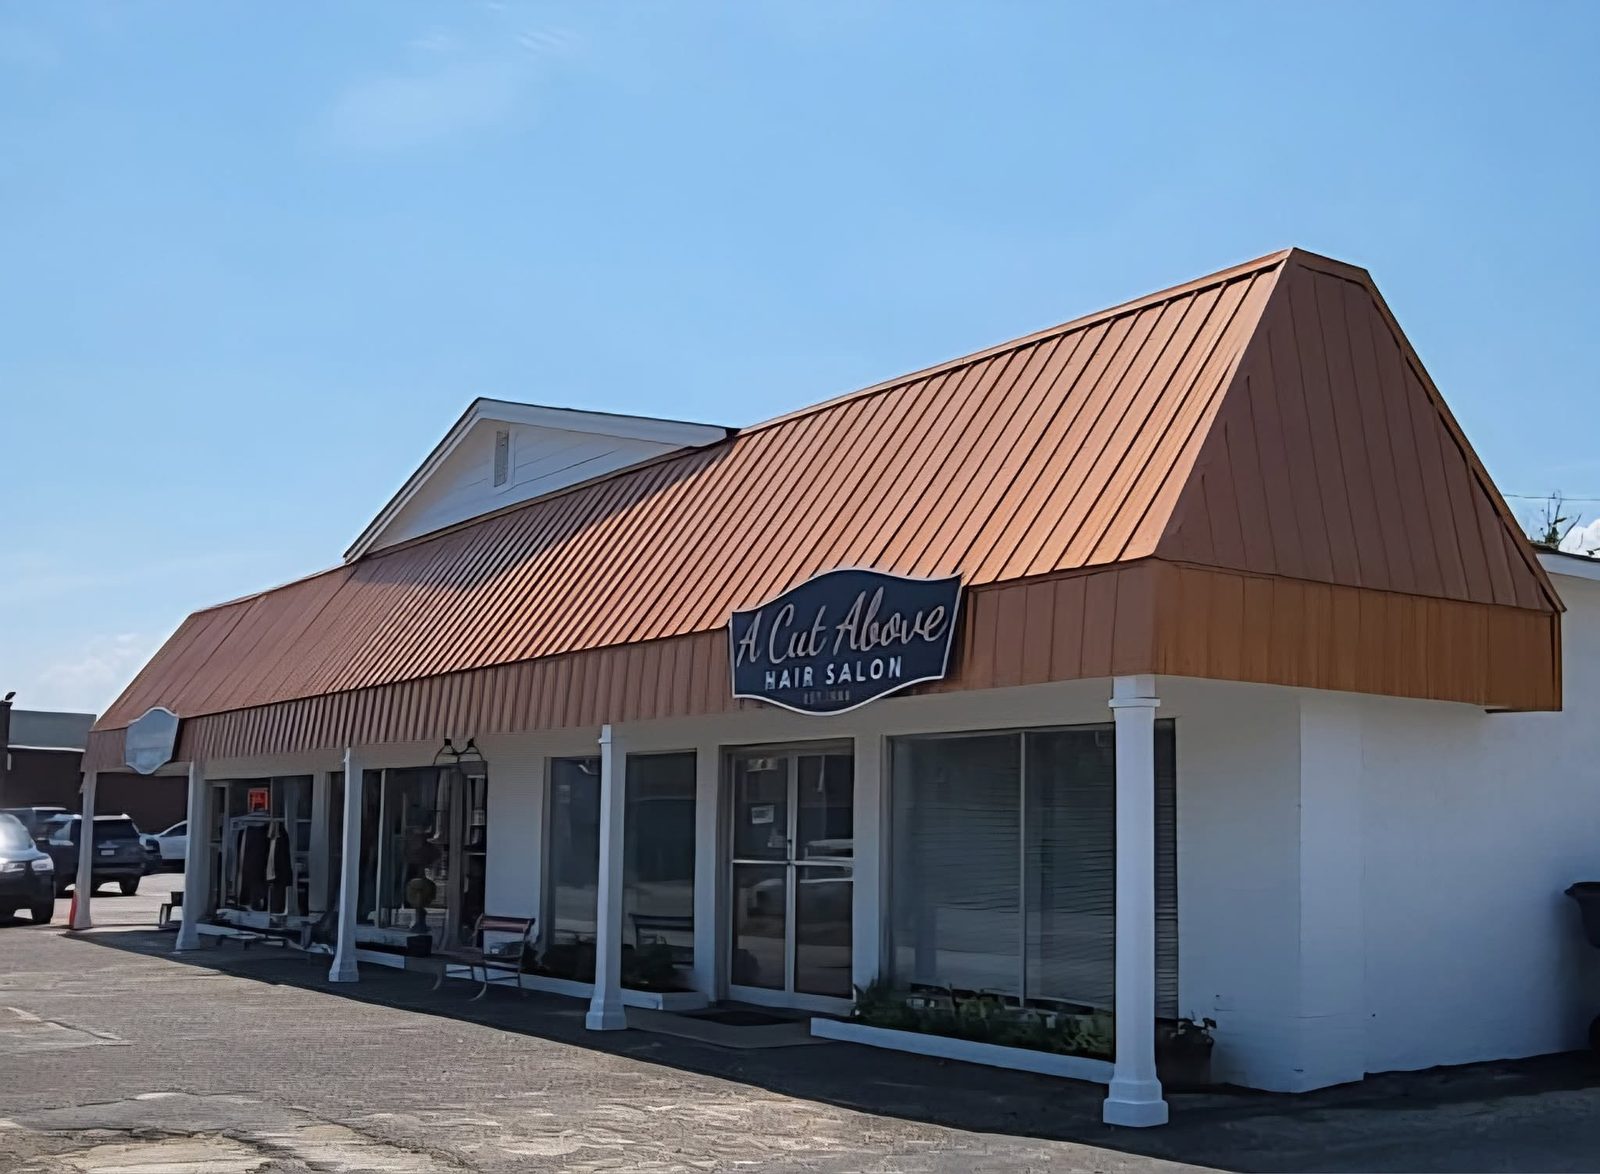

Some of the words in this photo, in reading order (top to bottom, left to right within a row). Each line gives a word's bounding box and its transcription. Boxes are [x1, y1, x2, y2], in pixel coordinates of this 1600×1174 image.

[736, 611, 763, 667] A
[769, 603, 828, 664] Cut
[833, 586, 947, 656] Above
[765, 666, 814, 690] HAIR
[825, 656, 902, 685] SALON
